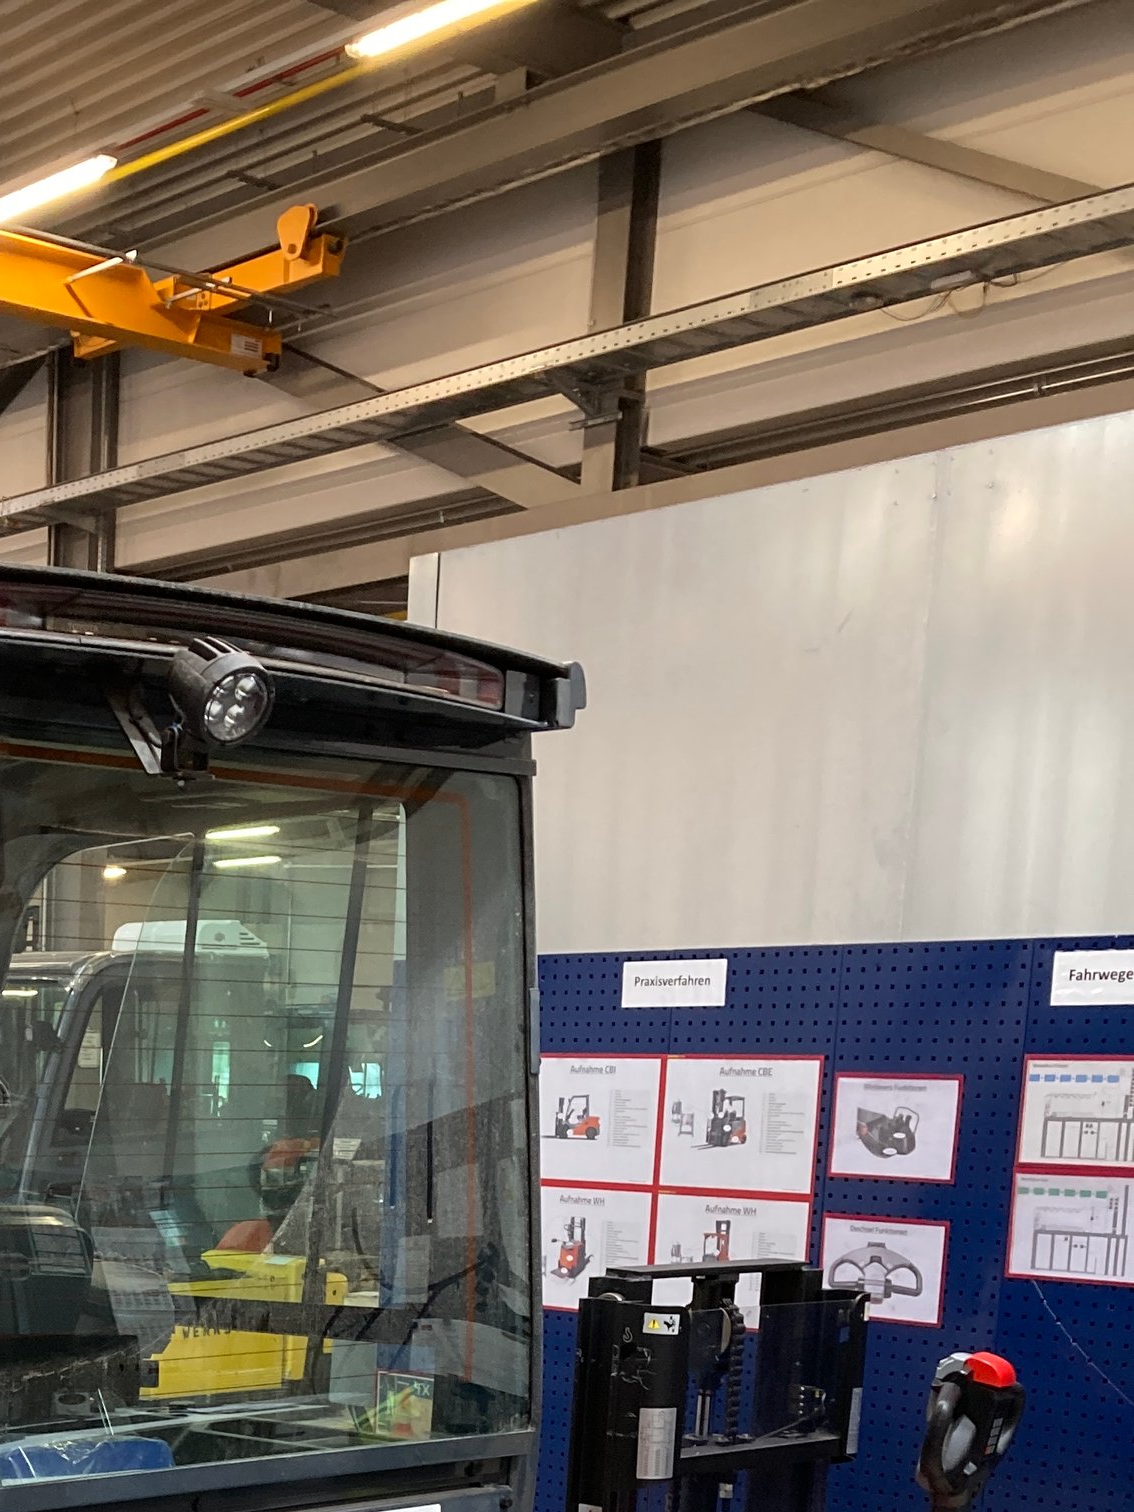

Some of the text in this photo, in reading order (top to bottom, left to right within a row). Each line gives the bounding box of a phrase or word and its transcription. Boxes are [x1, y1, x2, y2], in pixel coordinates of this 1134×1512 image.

[634, 974, 711, 987] Praxisverfahren
[1069, 968, 1134, 983] Fahrwege
[570, 1065, 603, 1074] Aufnahme
[719, 1066, 756, 1076] Aufnahme
[560, 1194, 592, 1205] Aufnahme
[705, 1204, 740, 1215] Aufnahme
